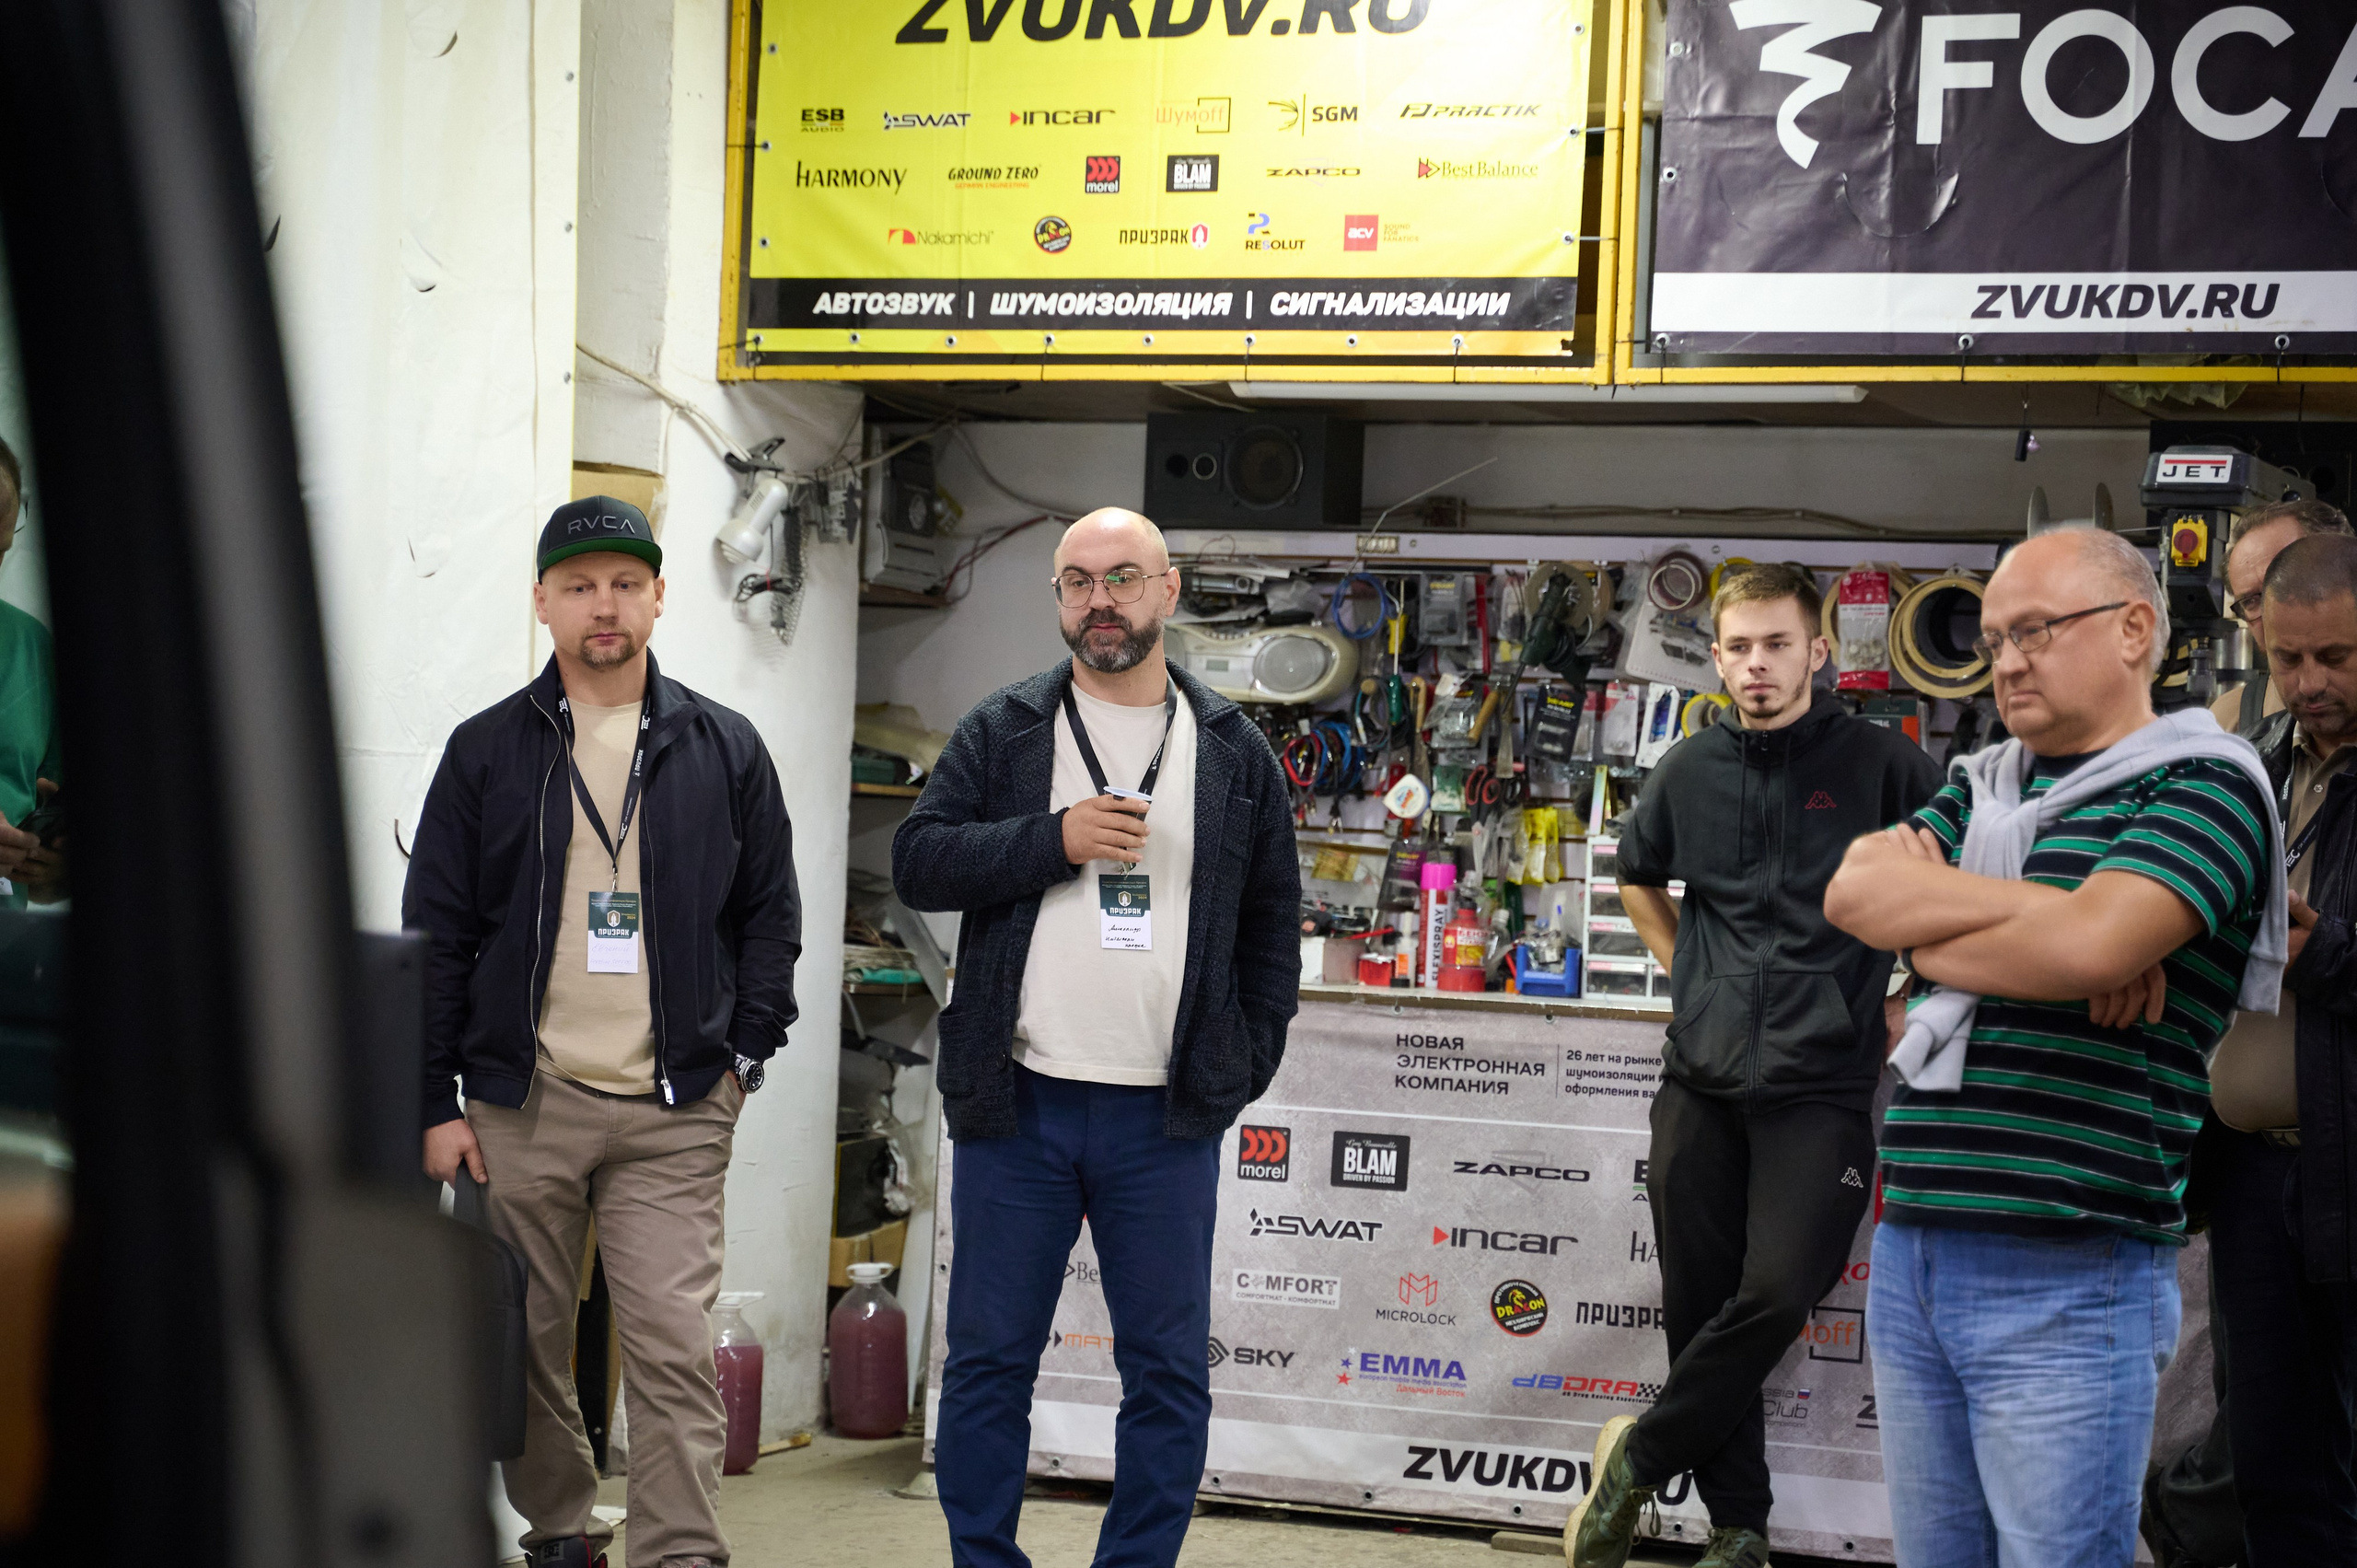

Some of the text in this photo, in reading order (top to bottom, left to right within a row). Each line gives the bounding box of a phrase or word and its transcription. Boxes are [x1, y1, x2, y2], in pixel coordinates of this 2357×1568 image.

[895, 0, 1431, 43] ZVUKDV.RU
[801, 109, 844, 122] ESB
[1023, 110, 1116, 125] incar
[1312, 106, 1358, 122] SGM
[1432, 103, 1541, 118] PRACTIK
[893, 112, 971, 128] SWAT
[796, 160, 907, 195] HARMONY
[948, 167, 1039, 180] GROUND ZERO
[1174, 163, 1212, 183] BLAM
[1267, 168, 1360, 178] ZAPCO
[1086, 181, 1119, 193] morel
[916, 230, 991, 245] Nakamichi
[1120, 229, 1189, 244] ПРИЗРАК
[1246, 239, 1306, 250] RESOLUT
[812, 292, 1512, 319] АВТОЗВУК ШУМОИЗОЛЯЦИЯ СИГНАЛИЗАЦИИ
[1970, 283, 2281, 319] ZVUKDV.RU
[2162, 465, 2226, 478] JET
[567, 515, 636, 535] RVCA
[598, 928, 630, 936] ПРИЗРАК
[1432, 909, 1444, 981] FLEXISPRAY
[1396, 1034, 1464, 1051] НОВАЯ
[1397, 1054, 1546, 1076] ЭЛЕКТРОННАЯ
[1566, 1050, 1662, 1066] 26 лет на рынке
[1566, 1068, 1655, 1083] шумоизоляции
[1395, 1074, 1509, 1095] КОМПАНИЯ
[1565, 1084, 1639, 1098] оформления
[1343, 1147, 1398, 1177] BLAM
[1240, 1164, 1286, 1179] morel
[1342, 1173, 1396, 1184] DRIVEN BY PASSION
[1453, 1161, 1590, 1182] ZAPCO
[1264, 1214, 1383, 1242] SWAT
[1450, 1227, 1579, 1256] incar
[1236, 1292, 1336, 1306] COMFORTMAT КОМФОРТМАТ
[1495, 1297, 1546, 1318] DRAGON
[1575, 1301, 1666, 1330] ПРИЗРА
[1376, 1308, 1457, 1326] MICROLOCK
[1063, 1334, 1114, 1350] MAT
[1234, 1347, 1295, 1368] SKY
[1360, 1353, 1467, 1381] EMMA
[1358, 1374, 1387, 1382] european
[1411, 1378, 1431, 1387] media
[1434, 1380, 1467, 1388] association
[1436, 1387, 1466, 1398] Восток
[1762, 1388, 1794, 1398] ssia
[1403, 1445, 1692, 1506] ZVUKDU
